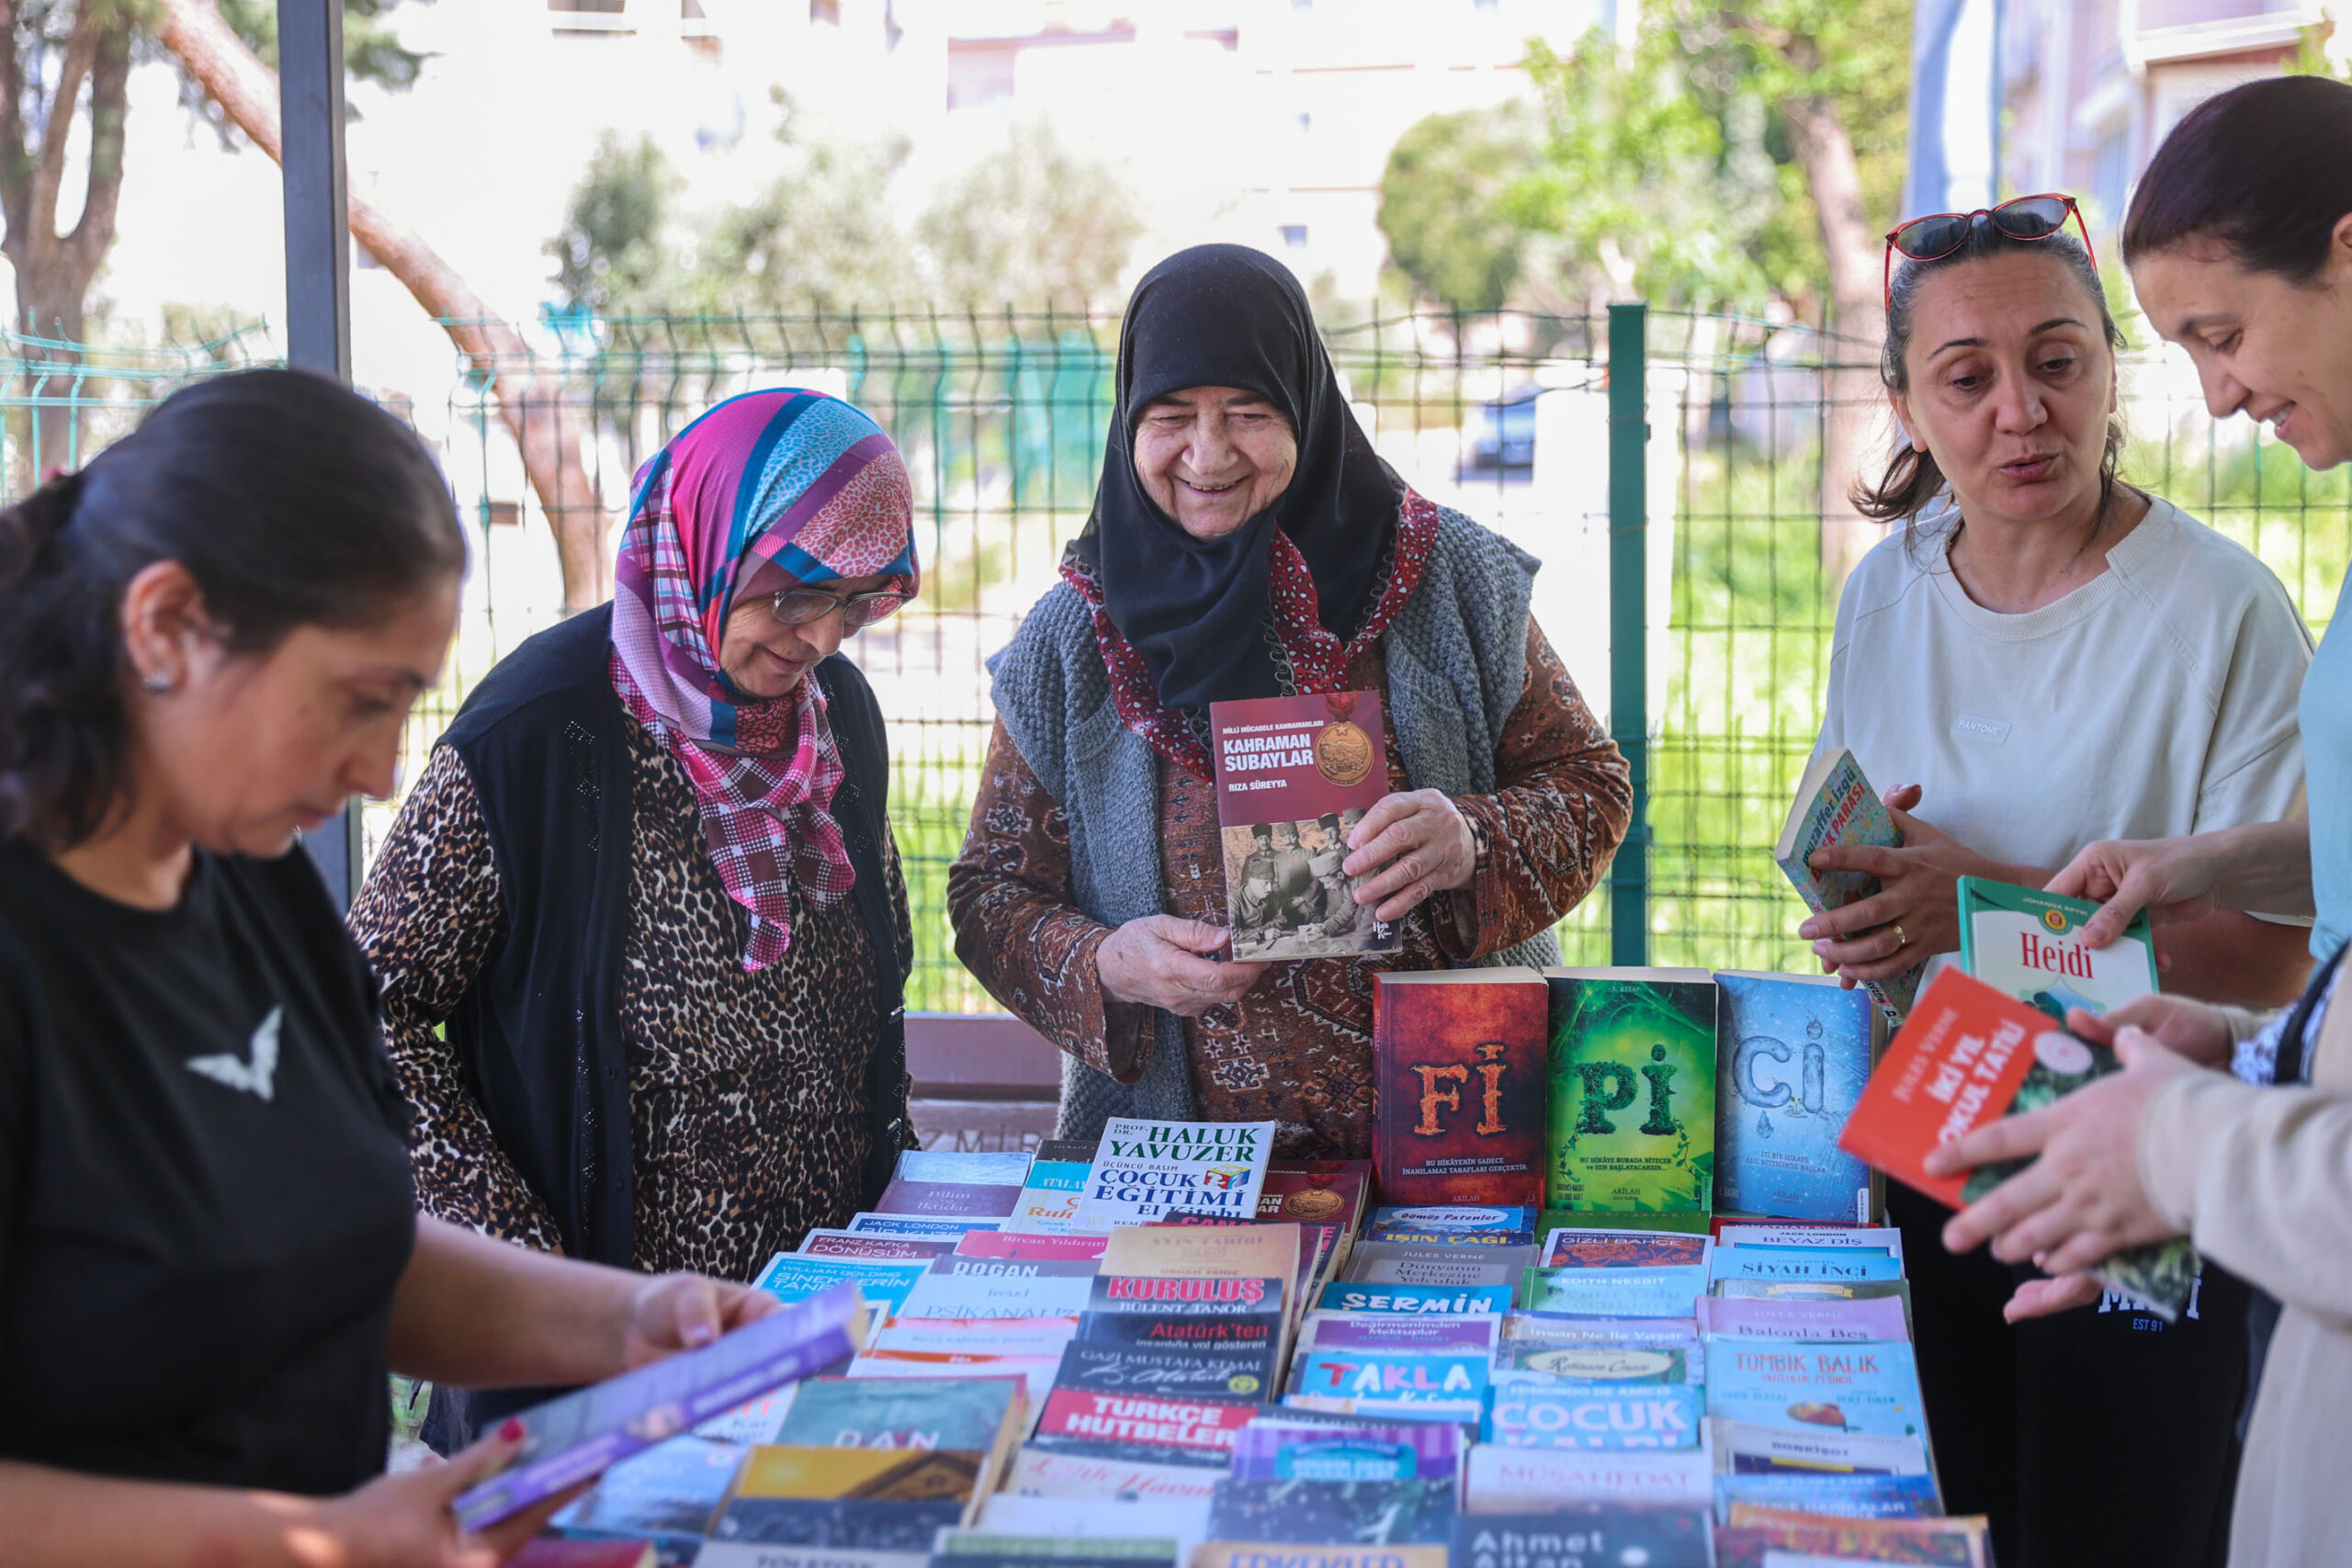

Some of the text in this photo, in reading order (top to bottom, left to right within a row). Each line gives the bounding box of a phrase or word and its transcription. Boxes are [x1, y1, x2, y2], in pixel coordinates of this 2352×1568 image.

[1223, 733, 1311, 754] KAHRAMAN
[1225, 750, 1315, 773] SUBAYLAR
[1228, 779, 1287, 792] RIZA SÜREYYA
[1828, 781, 1866, 835] PARASI
[2022, 897, 2064, 909] JOHANNA
[2019, 931, 2095, 979] Heidi
[1950, 1033, 1985, 1066] YIL
[1938, 1084, 1991, 1147] OKUL
[1148, 1126, 1260, 1145] HALUK
[1110, 1141, 1254, 1162] YAVUZER
[1103, 1161, 1143, 1169] ÜÇÜNCÜ
[1477, 1156, 1505, 1165] SADECE
[1402, 1167, 1448, 1176] İNANILAMAZ
[1449, 1165, 1487, 1174] TARAFLARI
[1100, 1169, 1200, 1189] ÇOCUK
[929, 1190, 971, 1199] Bilim
[1092, 1185, 1246, 1206] EĞİTİMİ
[1136, 1204, 1159, 1215] El
[1401, 1213, 1500, 1222] Gümüş Patenler
[865, 1220, 959, 1230] JACK LONDON
[818, 1237, 910, 1248] FRANZ KAFKA
[1002, 1235, 1105, 1247] Bircan Yıldırım
[1385, 1234, 1507, 1245] IŞIN ÇAĞI
[1763, 1236, 1826, 1245] BEYAZ
[1402, 1250, 1440, 1258] JULES
[782, 1266, 901, 1278] WILLIAM GOLDING
[953, 1261, 1039, 1277] DOĞAN
[1398, 1261, 1482, 1272] Dünyanın
[1742, 1263, 1867, 1277] SİYAH İNCİ
[776, 1272, 910, 1286] SİNEKERİN
[1395, 1269, 1482, 1279] Merkezine
[1399, 1276, 1471, 1286] Yolculuk
[1107, 1278, 1264, 1304] KURULUŞ
[1119, 1302, 1248, 1314] BÜLENT TANÖR
[1341, 1293, 1493, 1314] ŞERMİN
[1150, 1323, 1269, 1338] Atatürk'ten
[1738, 1325, 1820, 1338] Balonla
[2132, 1318, 2164, 1332] EST 91
[1368, 1328, 1441, 1337] Mektuplar
[1582, 1329, 1605, 1340] Ne
[1634, 1330, 1684, 1341] Yaşar
[1125, 1356, 1204, 1369] MUSTAFA
[1206, 1359, 1264, 1372] KEMAL
[1549, 1357, 1606, 1372] Robinson
[1735, 1352, 1880, 1374] TOMBİK BALIK
[1318, 1363, 1473, 1393] TAKLA
[1066, 1413, 1237, 1446] HUTBELER
[1472, 1529, 1606, 1554] Ahmet
